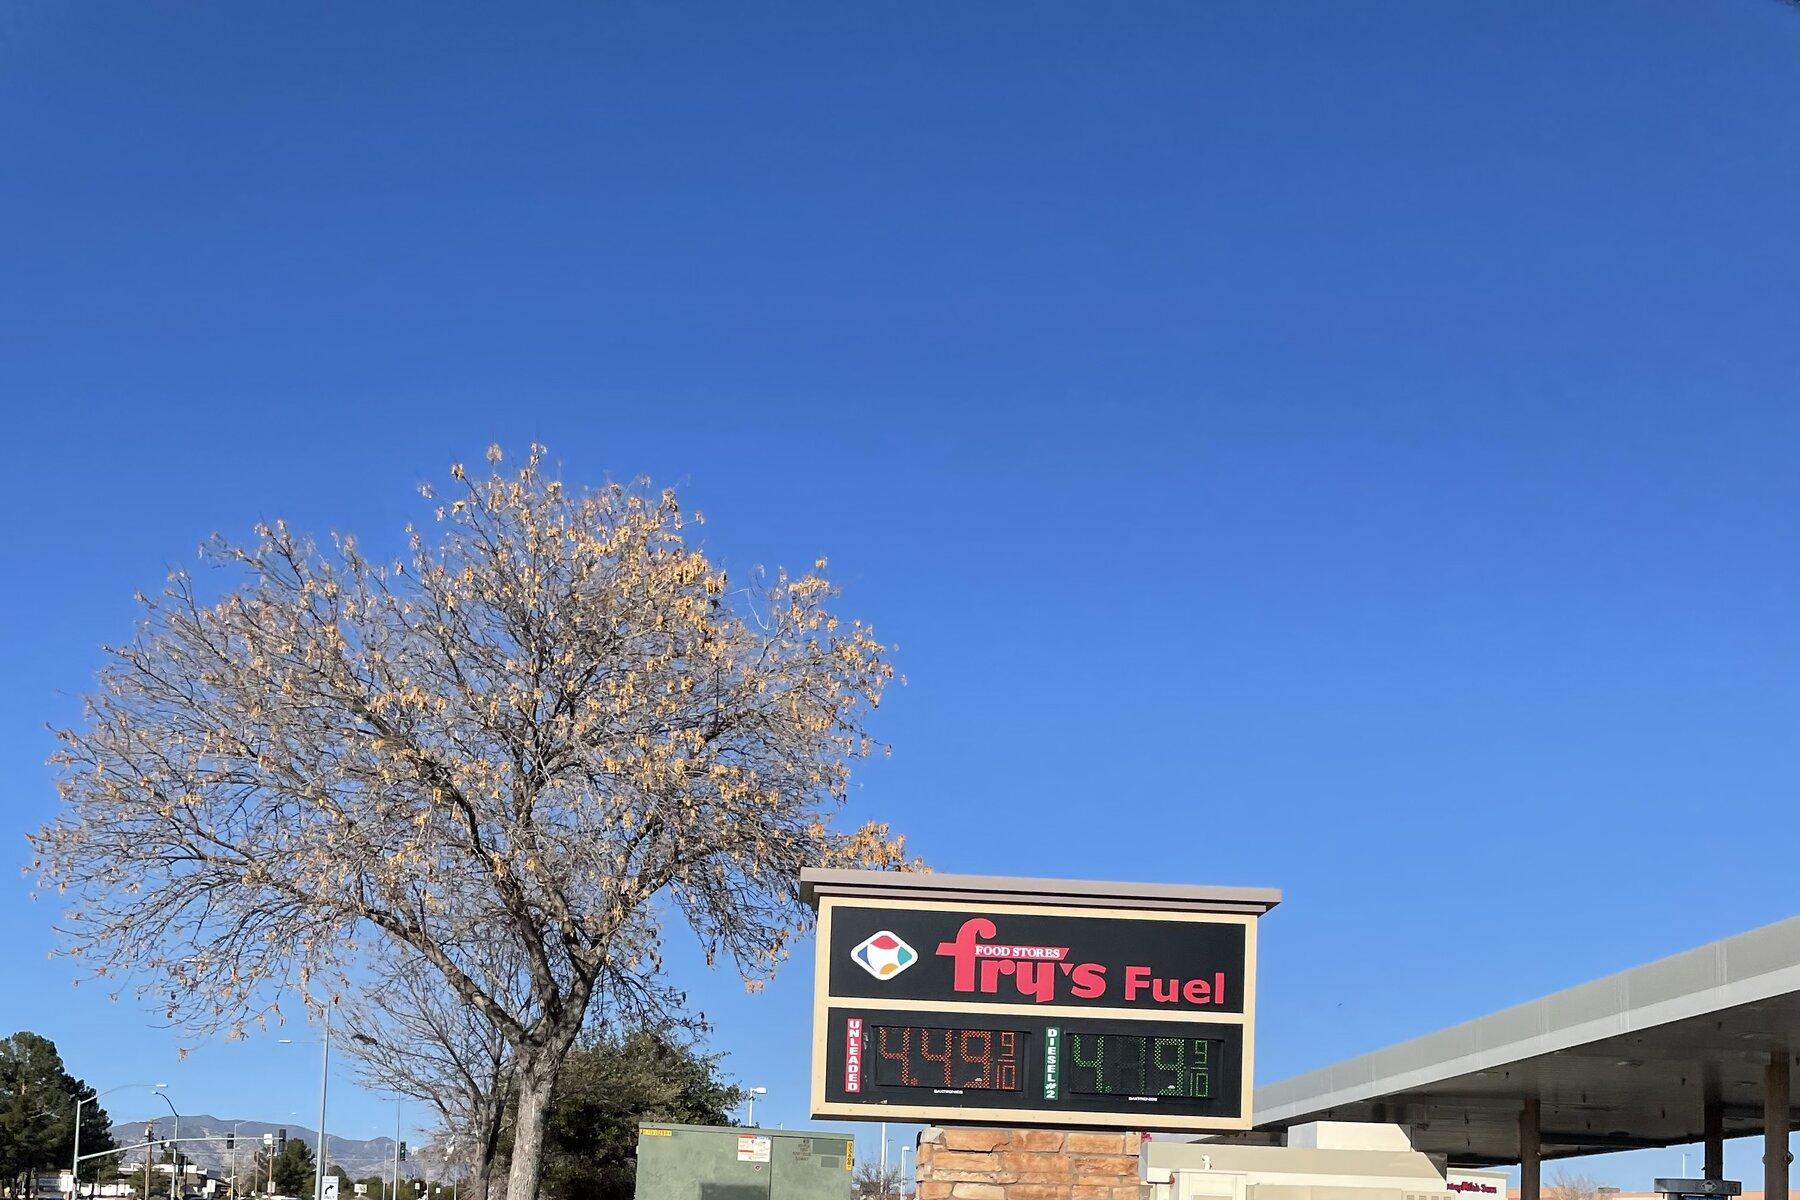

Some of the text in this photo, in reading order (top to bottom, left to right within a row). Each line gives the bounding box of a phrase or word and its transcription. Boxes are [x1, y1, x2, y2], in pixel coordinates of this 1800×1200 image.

[936, 917, 1225, 1004] fry's Fuel
[975, 945, 1060, 959] FOOD STORES
[847, 1020, 860, 1092] UNLEADED
